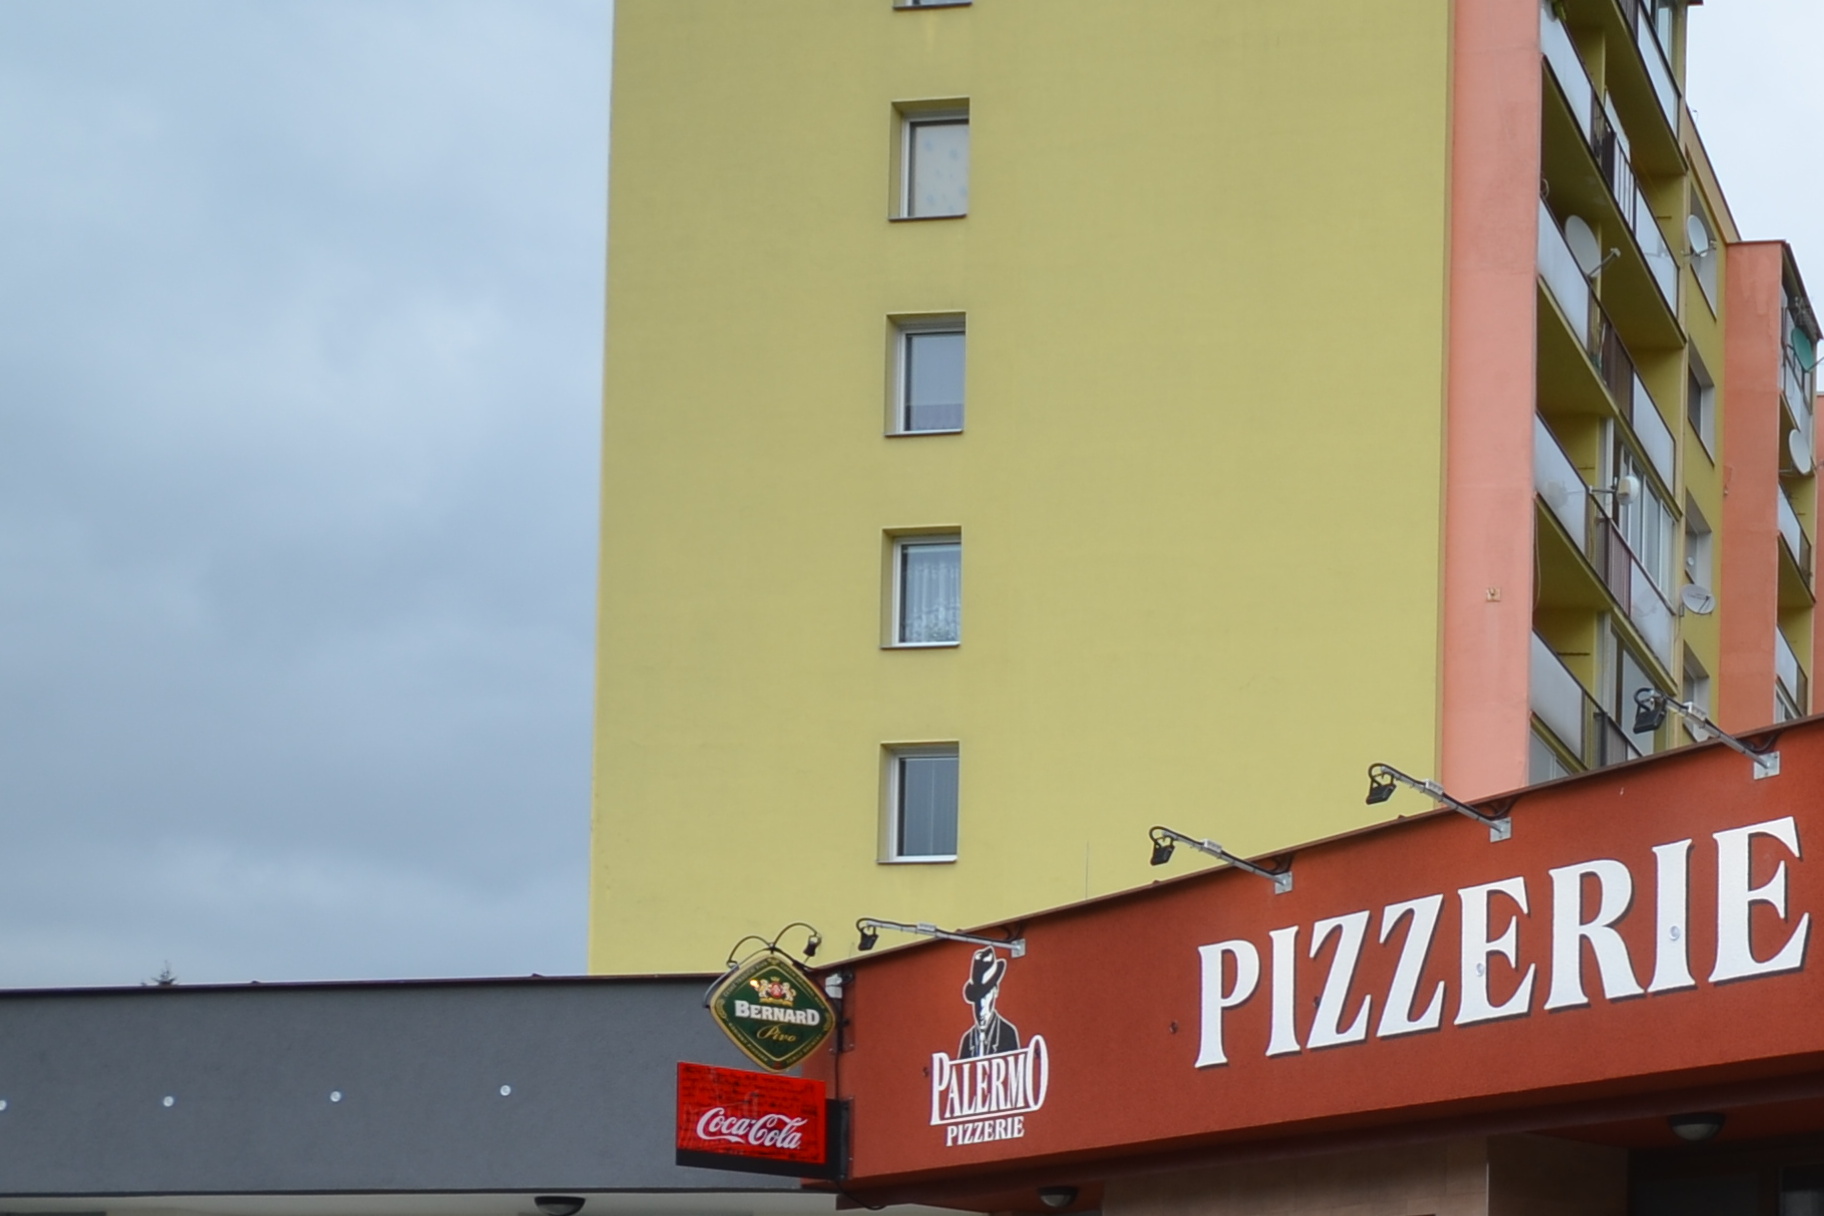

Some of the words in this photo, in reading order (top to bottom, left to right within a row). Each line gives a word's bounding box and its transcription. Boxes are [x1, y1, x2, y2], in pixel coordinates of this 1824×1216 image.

[1194, 815, 1809, 1069] PIZZERIE
[734, 999, 821, 1026] BERNARD
[757, 1023, 797, 1042] Pivo
[929, 1034, 1049, 1126] PALERMO
[696, 1107, 808, 1149] Coca-Cola
[945, 1115, 1025, 1147] PIZZERIE
